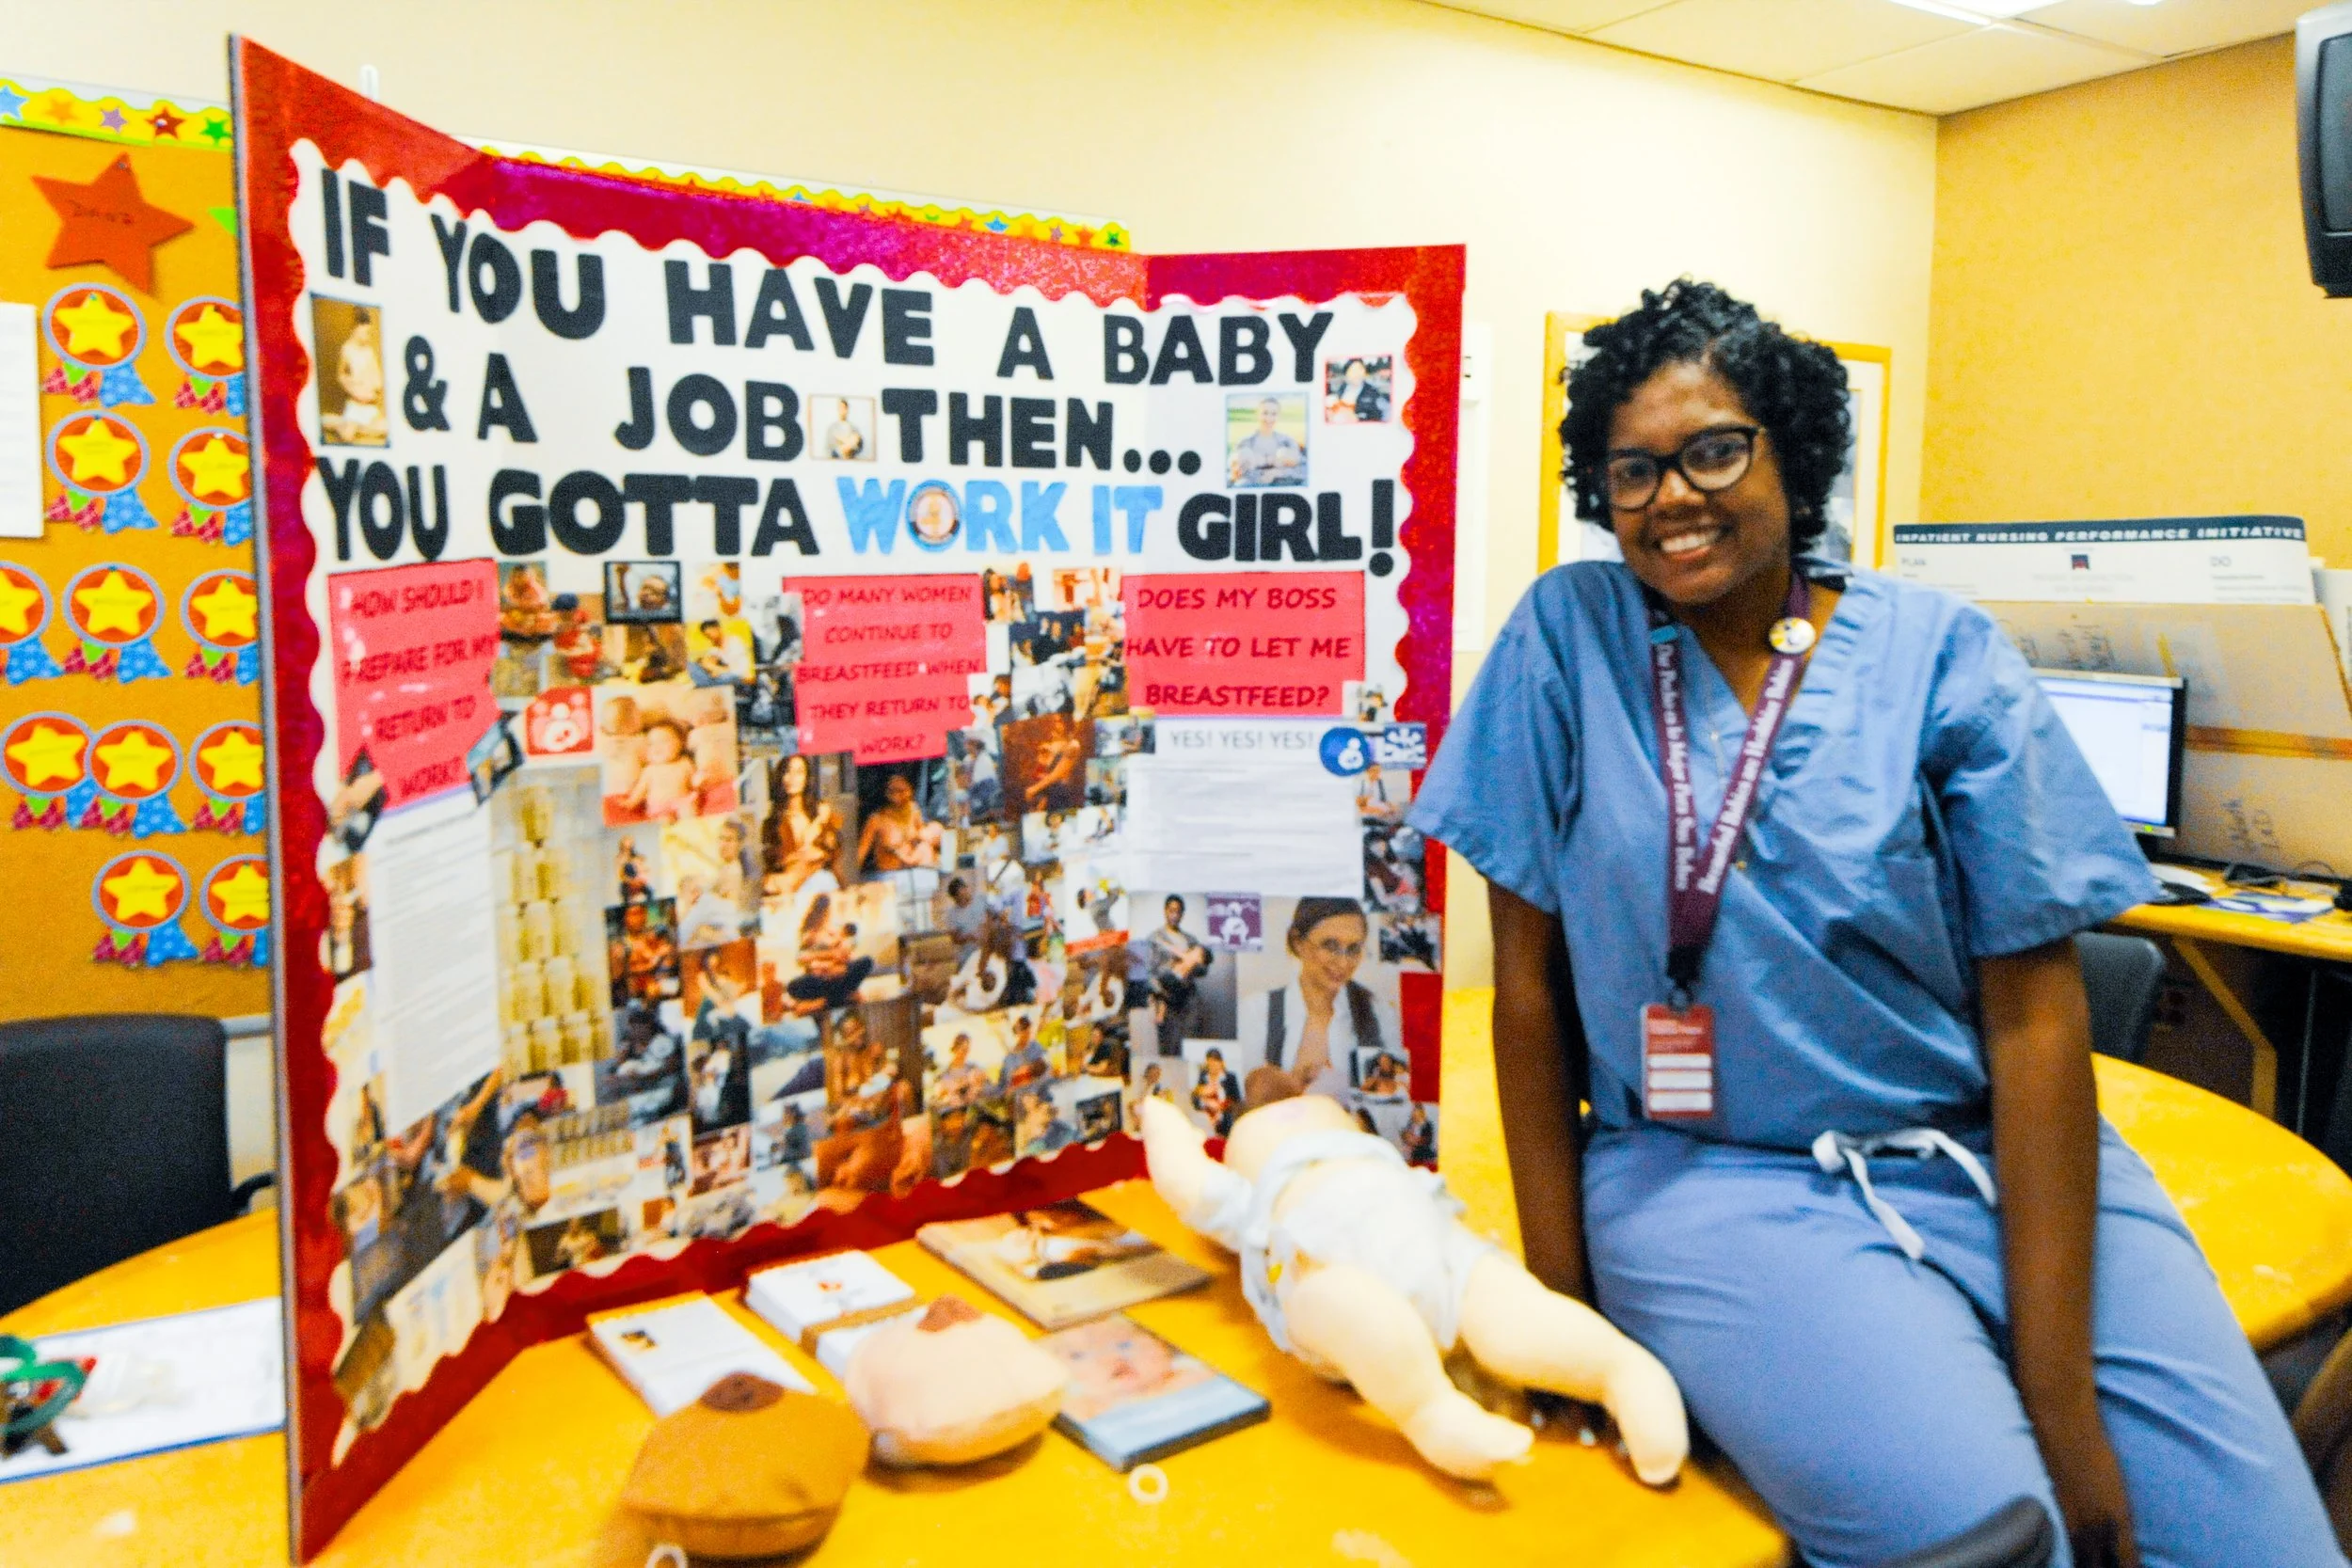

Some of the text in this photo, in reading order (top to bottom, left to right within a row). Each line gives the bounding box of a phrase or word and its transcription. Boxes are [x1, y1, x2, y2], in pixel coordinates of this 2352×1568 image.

[321, 167, 1335, 387] IF YOU HAVE A BABY
[402, 335, 1202, 477] & A JOB THEN...
[314, 455, 1395, 578] YOU GOTTA WORK IT GIRL!
[1895, 526, 2303, 543] INPATIENT NURSING PERFORMANCE INITIATIVE
[803, 585, 973, 606] DO MANY WOMEN
[1137, 587, 1337, 610] DOES MY BOSS
[824, 622, 954, 644] CONTINUE TO
[1126, 636, 1352, 659] HAVE TO LET ME
[795, 657, 981, 684] BREASTFEED WHEN
[1144, 684, 1330, 707] BREASTFEED?
[810, 694, 970, 721] THEY RETURN TO
[861, 733, 926, 754] WORK?
[1169, 730, 1314, 749] YES! YES! YES!
